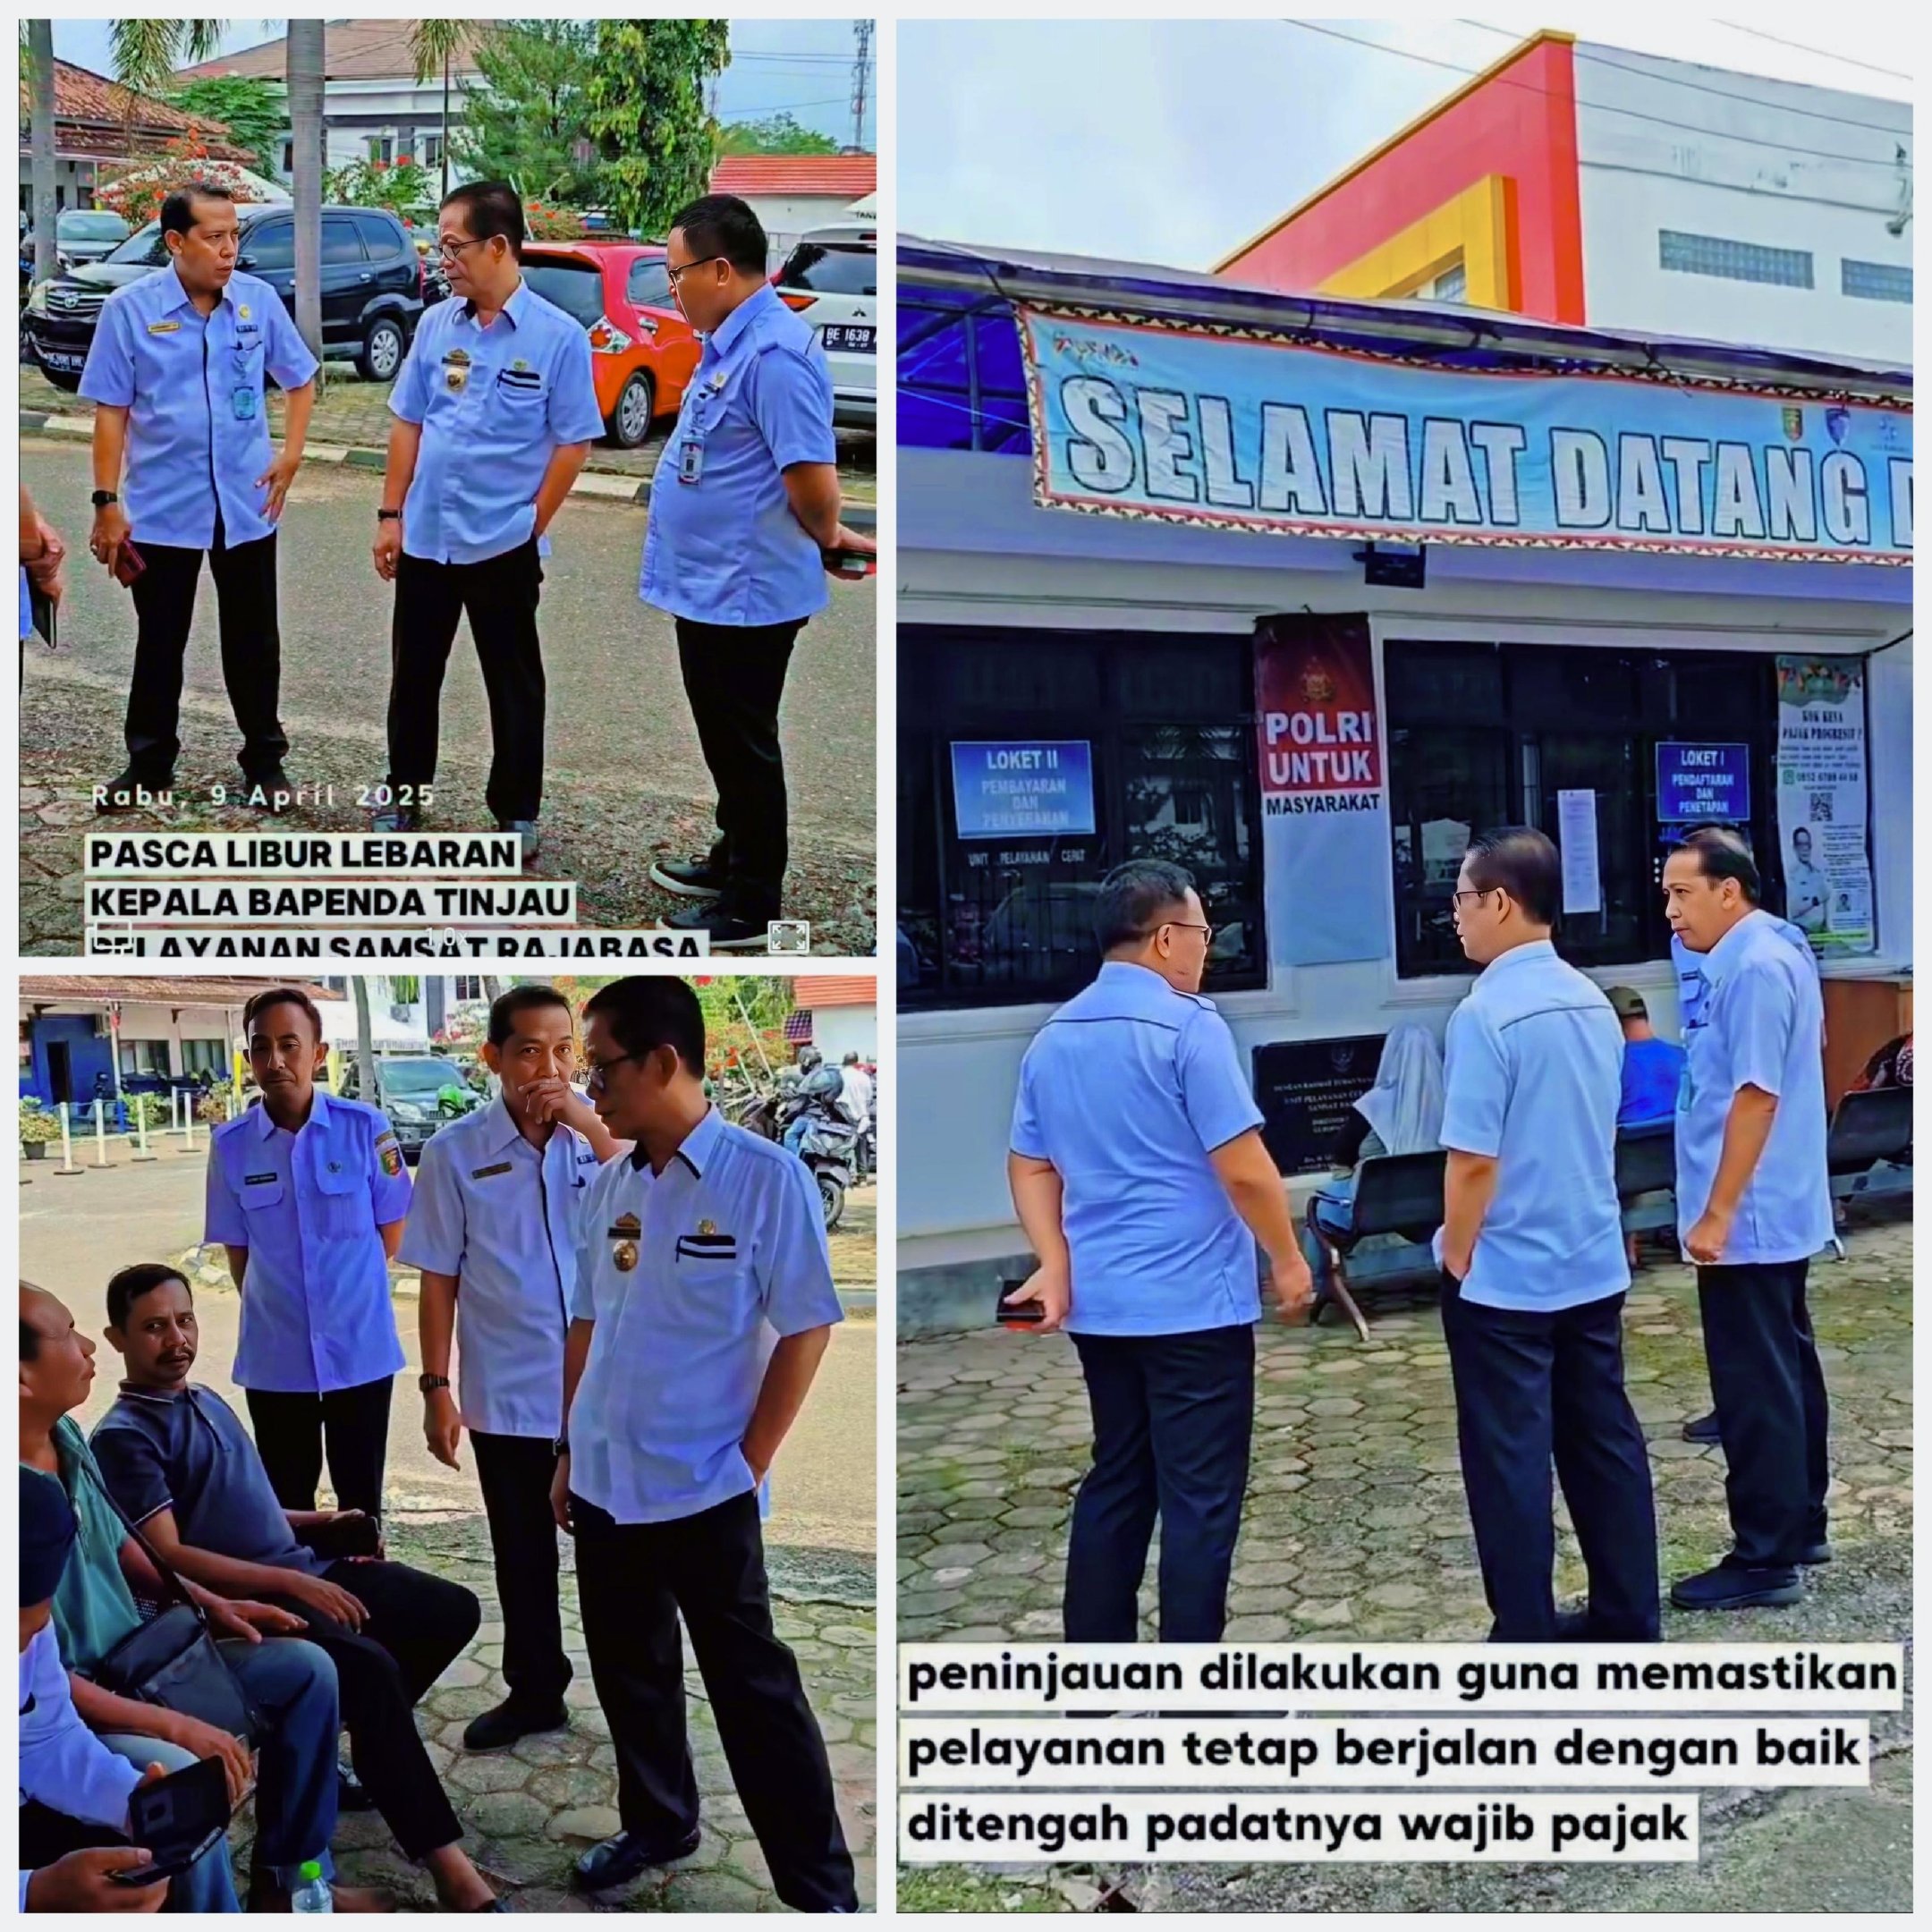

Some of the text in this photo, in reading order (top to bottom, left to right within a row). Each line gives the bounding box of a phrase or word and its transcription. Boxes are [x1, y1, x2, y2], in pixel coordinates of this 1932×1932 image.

[826, 327, 841, 341] BE
[1060, 375, 1527, 526] SELAMAT
[1549, 427, 1871, 546] DATANG
[1266, 712, 1373, 745] POLRI
[987, 750, 1058, 770] LOKET II
[1681, 750, 1725, 767] LOKET I
[1268, 750, 1374, 785] UNTUK
[982, 778, 1067, 795] PEMBAYARAN
[1672, 774, 1734, 787] PENDAFTARAN
[1696, 787, 1715, 801] DAN
[1012, 796, 1038, 810] DAN
[1267, 793, 1380, 816] MASYARAKAT
[1678, 801, 1730, 814] PENETAPAN
